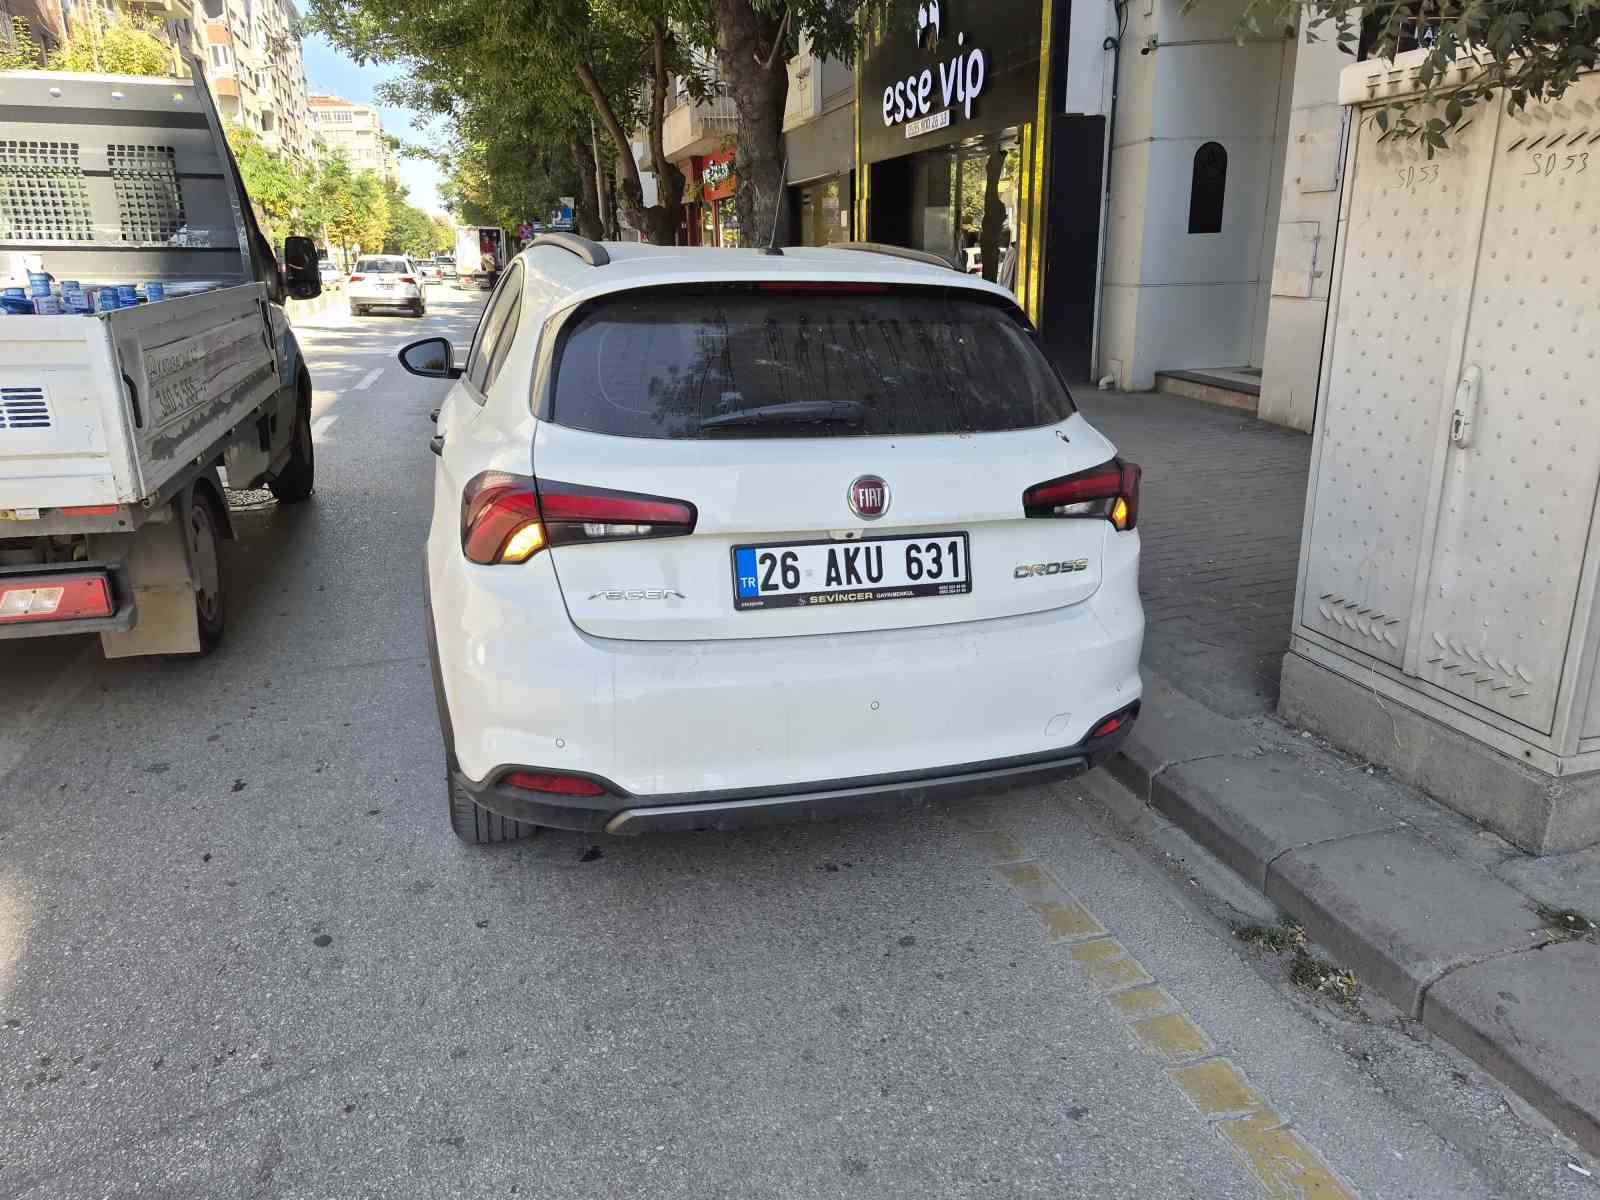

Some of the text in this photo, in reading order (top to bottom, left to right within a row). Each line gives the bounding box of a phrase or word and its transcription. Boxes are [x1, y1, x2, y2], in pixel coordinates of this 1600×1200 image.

[882, 31, 984, 127] esse vip
[858, 487, 883, 509] FIAT
[758, 540, 960, 592] 26 AKU 631
[1013, 558, 1089, 580] CROSS
[740, 576, 757, 590] TR
